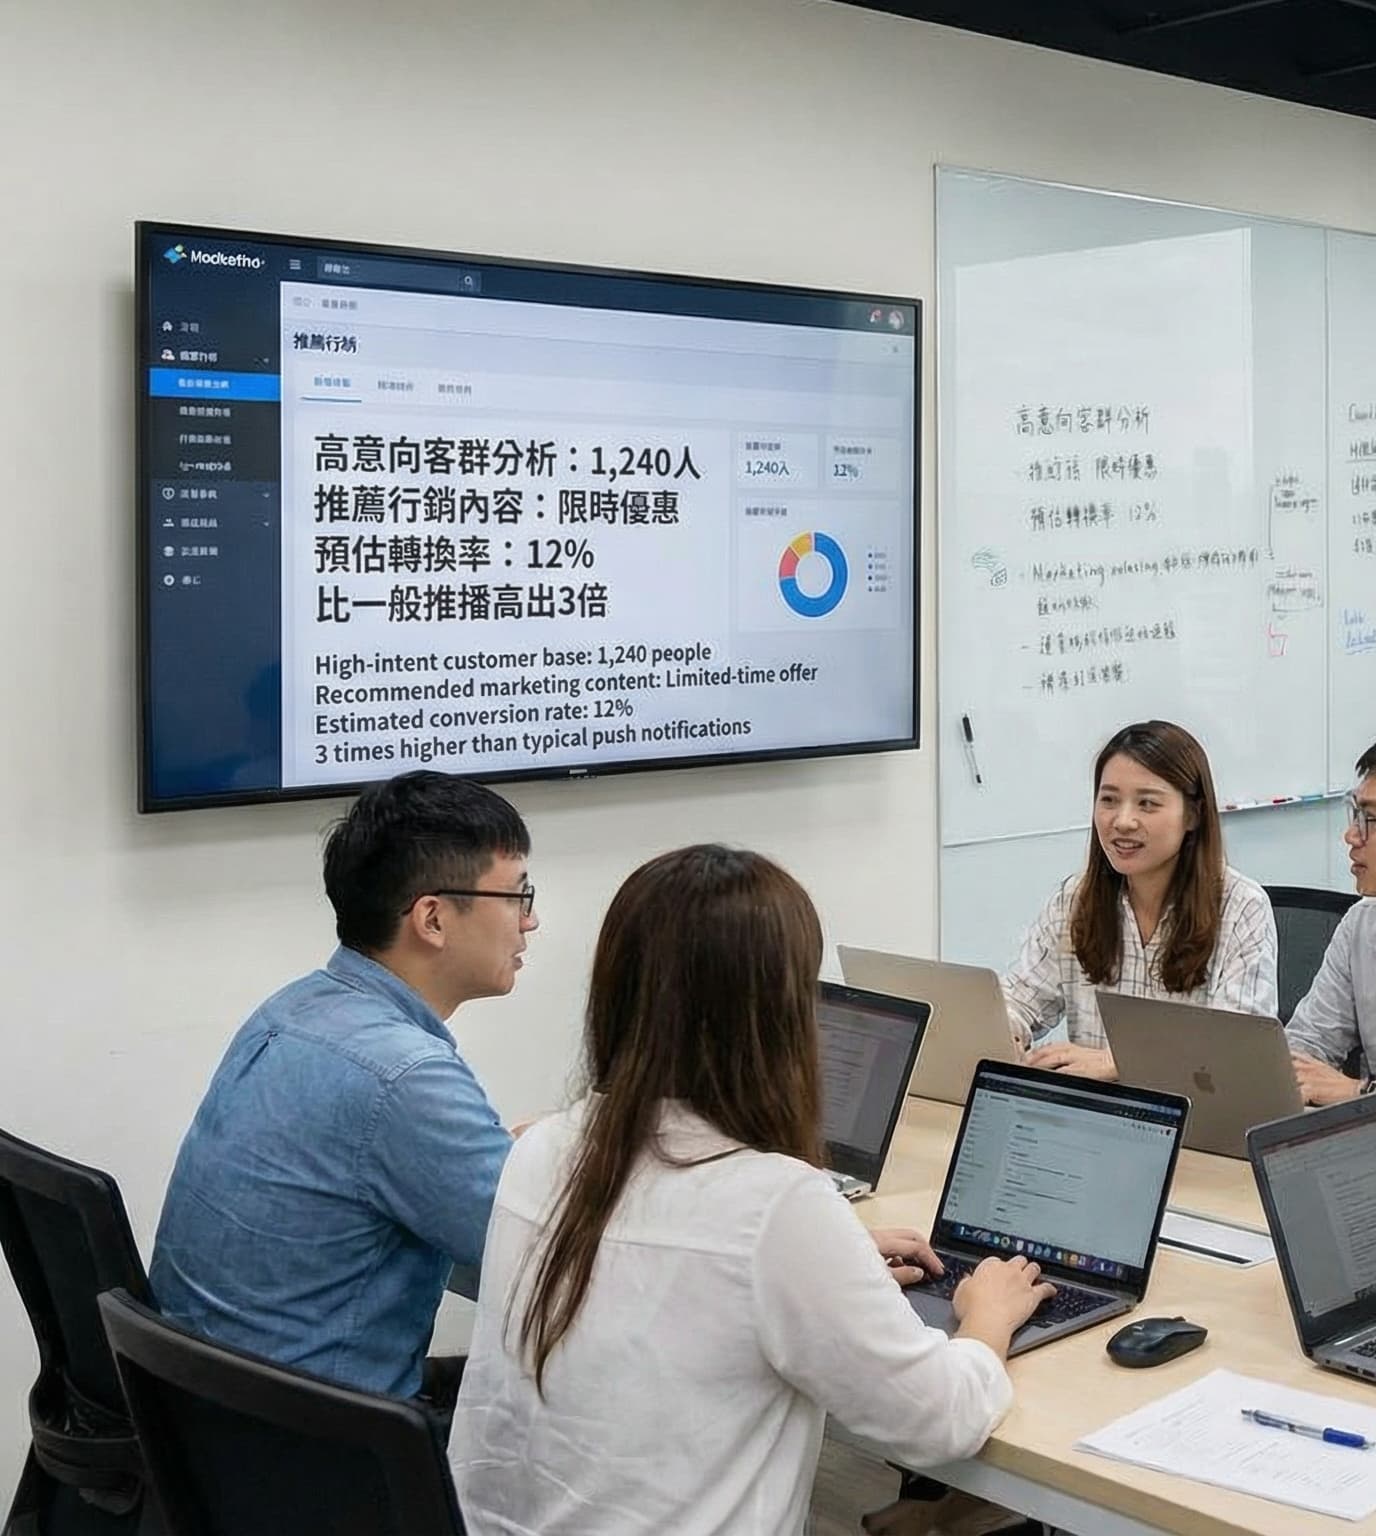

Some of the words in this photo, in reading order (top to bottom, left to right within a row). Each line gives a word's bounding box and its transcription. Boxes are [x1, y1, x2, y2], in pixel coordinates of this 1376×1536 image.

[314, 433, 701, 482] 高意向客群分析：1,240人
[314, 484, 679, 524] 推薦行銷內容：限時優惠
[314, 535, 595, 573] 預估轉換率：12%
[316, 582, 608, 623] 比一般推播高出3倍
[315, 652, 438, 680] High-intent
[443, 651, 538, 670] customer
[543, 647, 592, 667] base:
[598, 645, 647, 669] 1,240
[652, 642, 712, 667] people
[315, 678, 474, 705] Recommended
[480, 674, 581, 697] marketing
[585, 672, 661, 692] content:
[666, 666, 775, 688] Limited-time
[779, 663, 818, 682] offer
[316, 708, 424, 734] Estimated
[429, 704, 539, 728] conversion
[545, 702, 588, 722] rate:
[593, 699, 633, 718] 12%
[315, 744, 328, 764] 3
[333, 742, 394, 763] times
[400, 736, 467, 762] higher
[472, 733, 518, 753] than
[523, 726, 588, 754] typical
[593, 724, 636, 750] push
[642, 718, 752, 742] notifications
